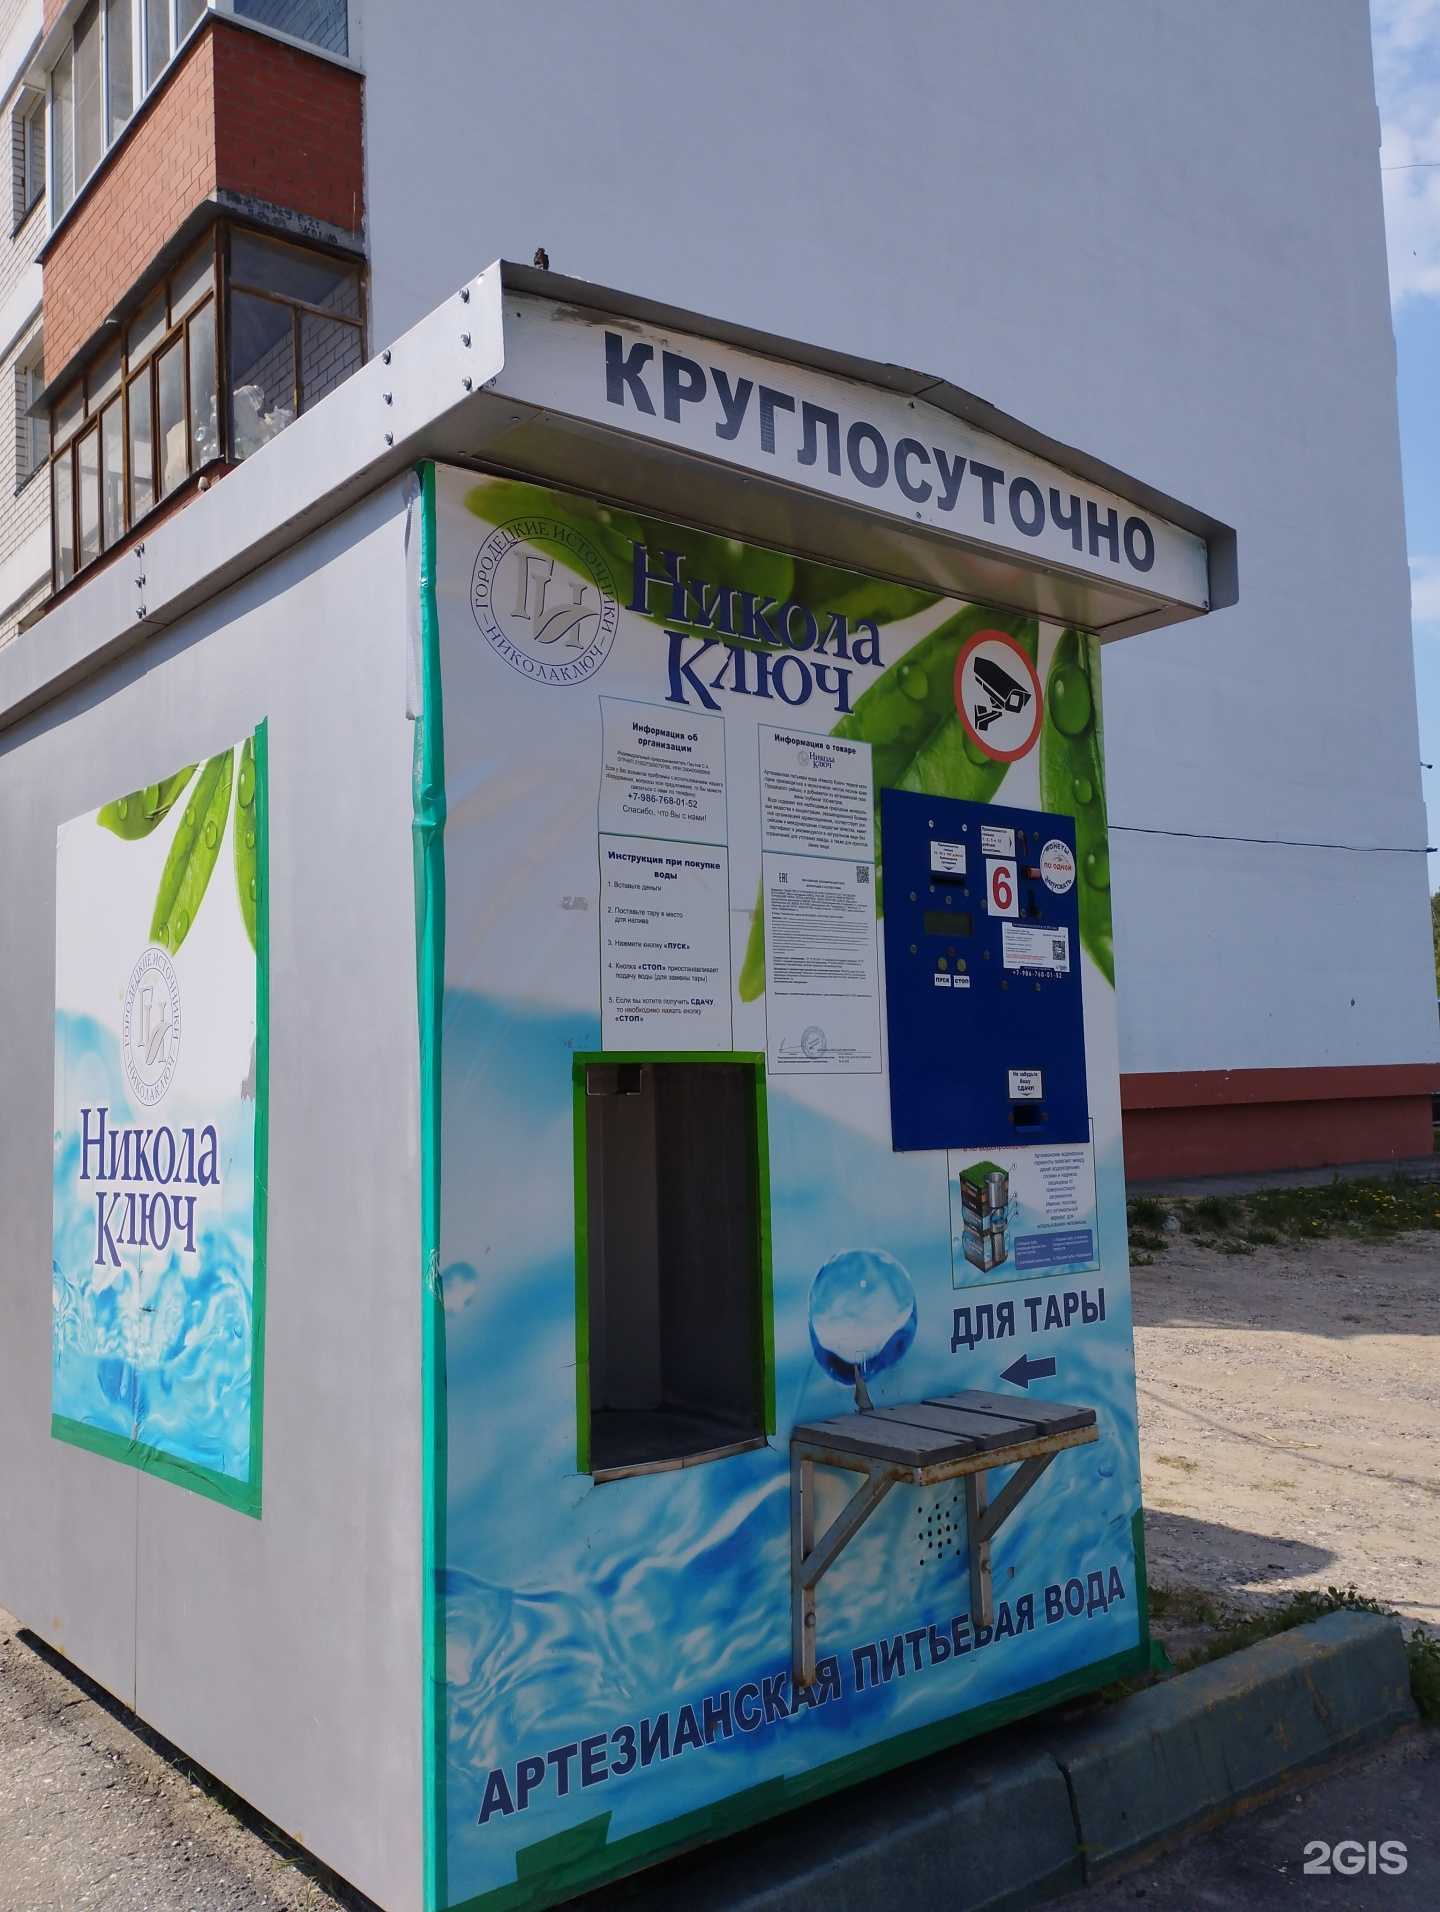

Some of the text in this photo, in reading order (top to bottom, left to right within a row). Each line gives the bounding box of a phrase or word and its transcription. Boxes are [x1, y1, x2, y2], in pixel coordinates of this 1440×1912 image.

[604, 331, 1155, 573] КРУГЛОСУТОЧНО
[476, 521, 616, 634] ГОРОДЕЦКИЕ ИСТОЧНИКИ
[626, 539, 885, 668] Никола
[486, 625, 603, 682] НИКОЛАКЛЮЧ
[664, 629, 854, 715] Ключ
[632, 722, 698, 741] Информация об
[638, 738, 692, 752] организации
[774, 734, 823, 749] Информация
[833, 746, 857, 755] товаре
[608, 851, 721, 870] Инструкция при покупке
[654, 871, 678, 880] воды
[992, 866, 1012, 910] 6
[79, 1107, 220, 1187] Никола
[95, 1191, 197, 1267] Ключ
[950, 1287, 1106, 1353] ДЛЯ ТАРЫ
[1043, 1565, 1127, 1626] ВОДА
